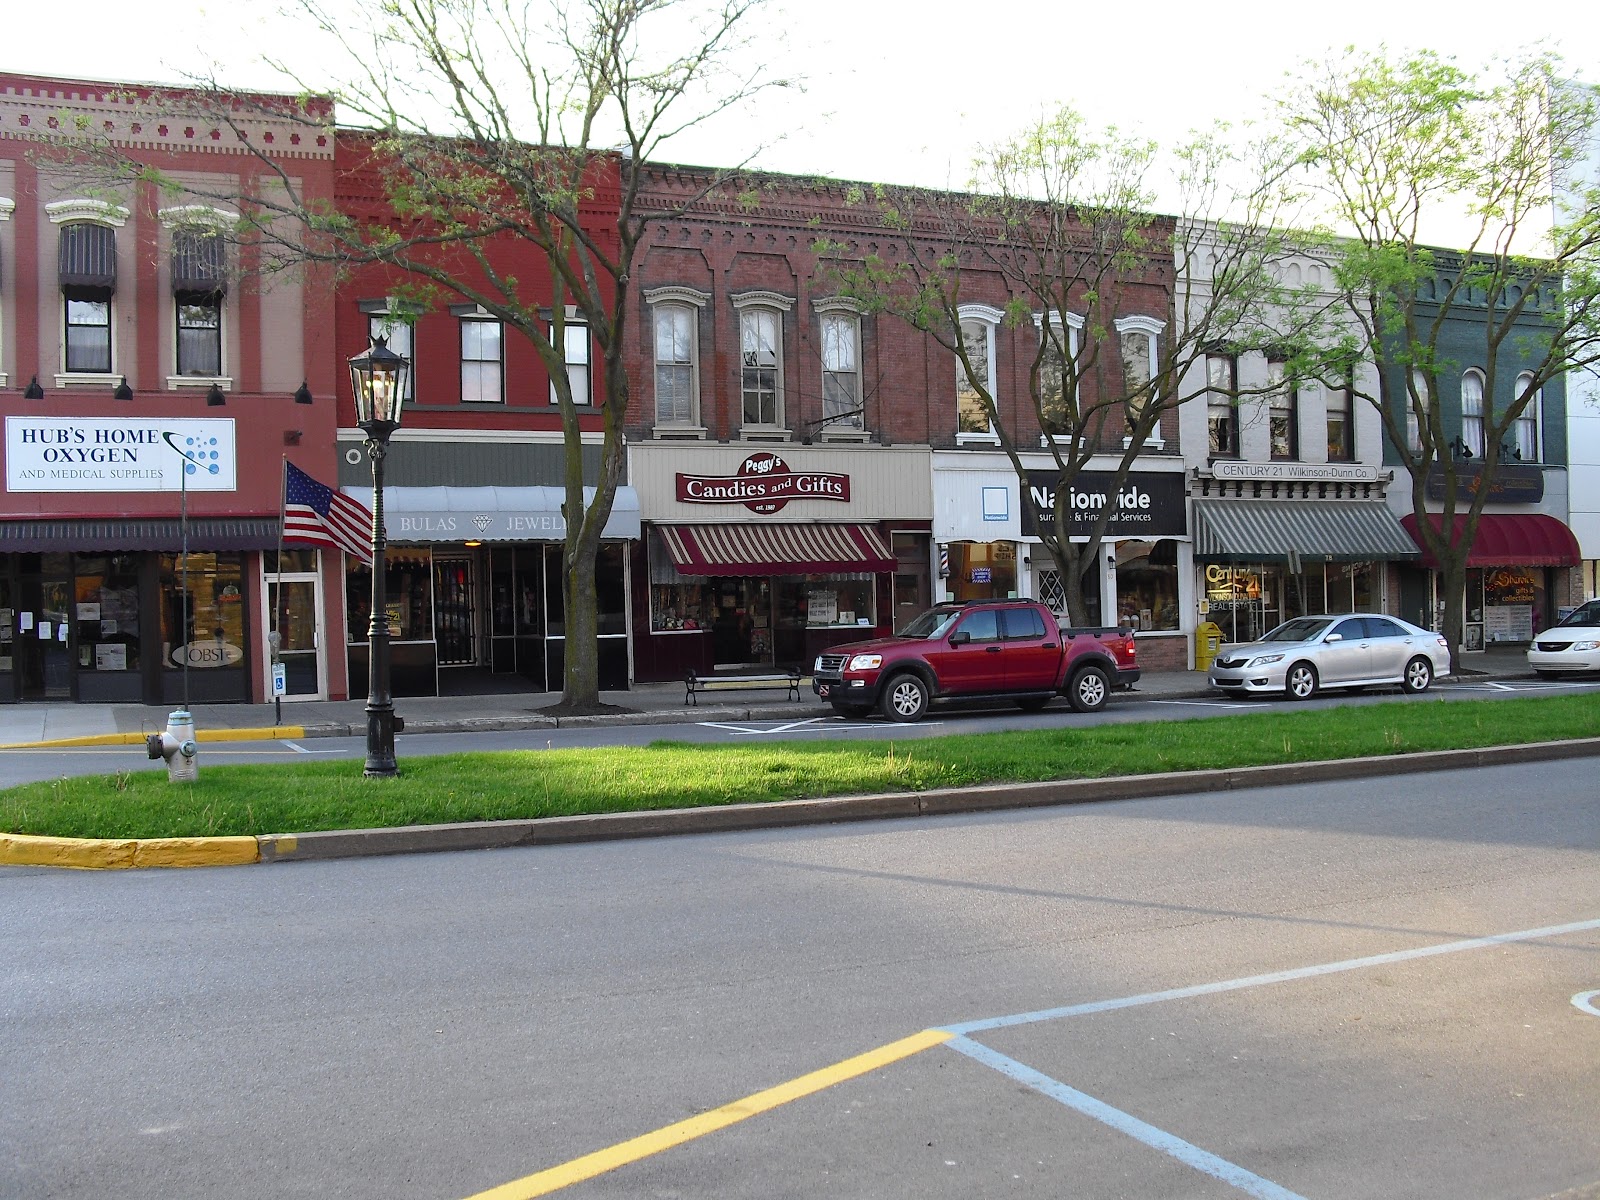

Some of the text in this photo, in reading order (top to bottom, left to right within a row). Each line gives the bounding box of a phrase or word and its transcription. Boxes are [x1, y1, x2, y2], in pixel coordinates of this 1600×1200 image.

[21, 427, 160, 444] HUB'S HOME
[43, 448, 138, 463] OXYGEN
[745, 455, 782, 474] Peggy's
[1223, 465, 1270, 476] CENTURY
[1272, 466, 1283, 476] 21
[1288, 466, 1353, 478] Wilkinson-Dunn
[19, 469, 164, 479] AND MEDICAL SUPPLIES
[686, 476, 843, 498] Candies and Gifts
[1030, 486, 1151, 510] Naionide
[1120, 511, 1152, 522] Services
[400, 517, 567, 531] BULAS JEWEL
[1206, 564, 1251, 582] Century
[1209, 601, 1228, 611] REAL
[186, 648, 226, 662] OBST
